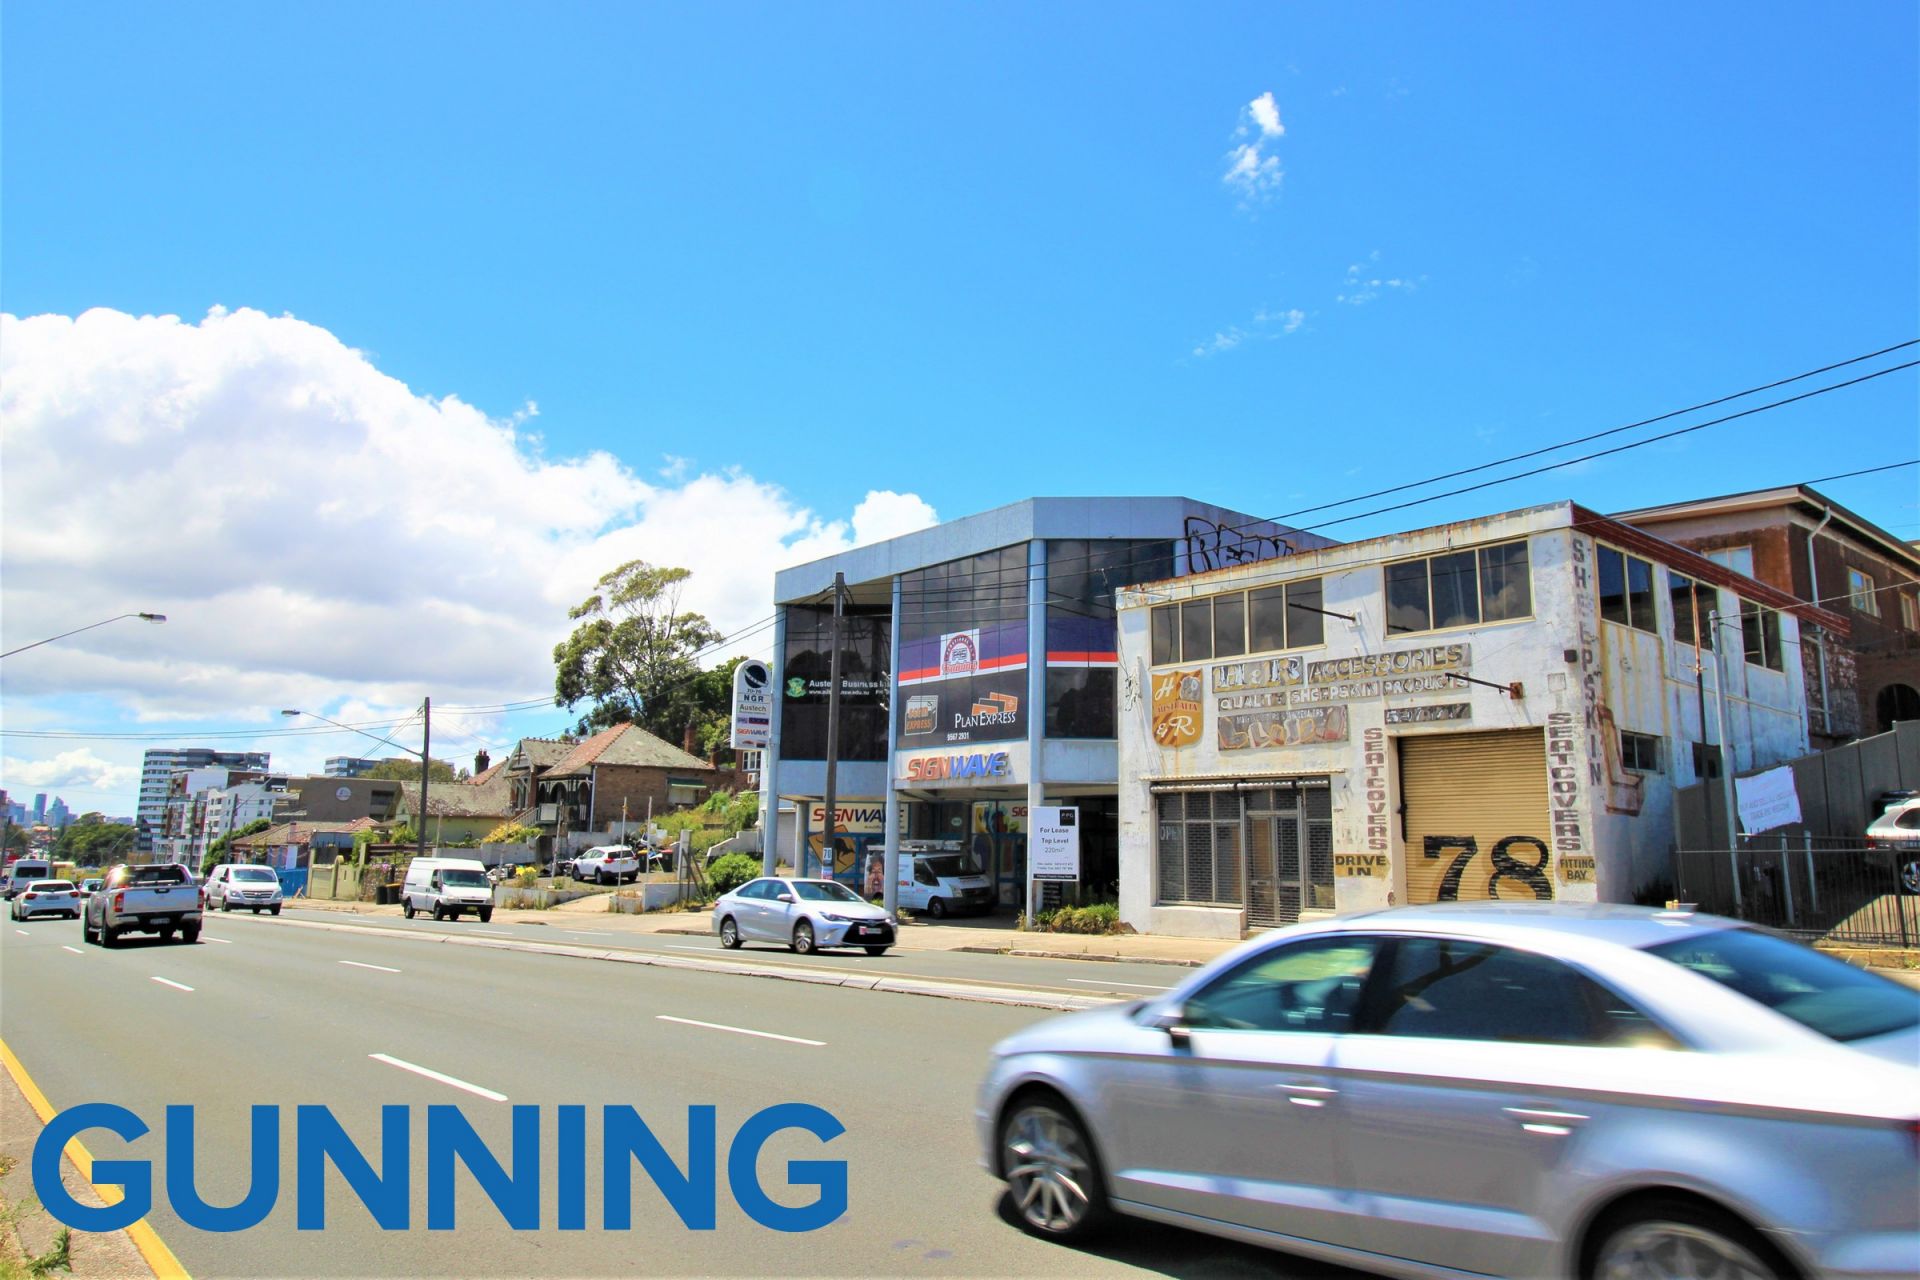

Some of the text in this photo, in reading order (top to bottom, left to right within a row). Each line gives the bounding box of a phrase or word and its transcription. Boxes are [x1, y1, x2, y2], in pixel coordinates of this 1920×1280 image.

[1308, 645, 1465, 683] ACCESSORIES
[743, 694, 764, 702] NGR
[740, 703, 767, 712] Austech
[906, 752, 1009, 782] SIGNWAVE
[1335, 855, 1387, 866] DRIVE
[1560, 858, 1595, 870] FITTING
[1347, 867, 1372, 877] IN
[1424, 835, 1553, 901] 78
[1566, 869, 1588, 880] BAY
